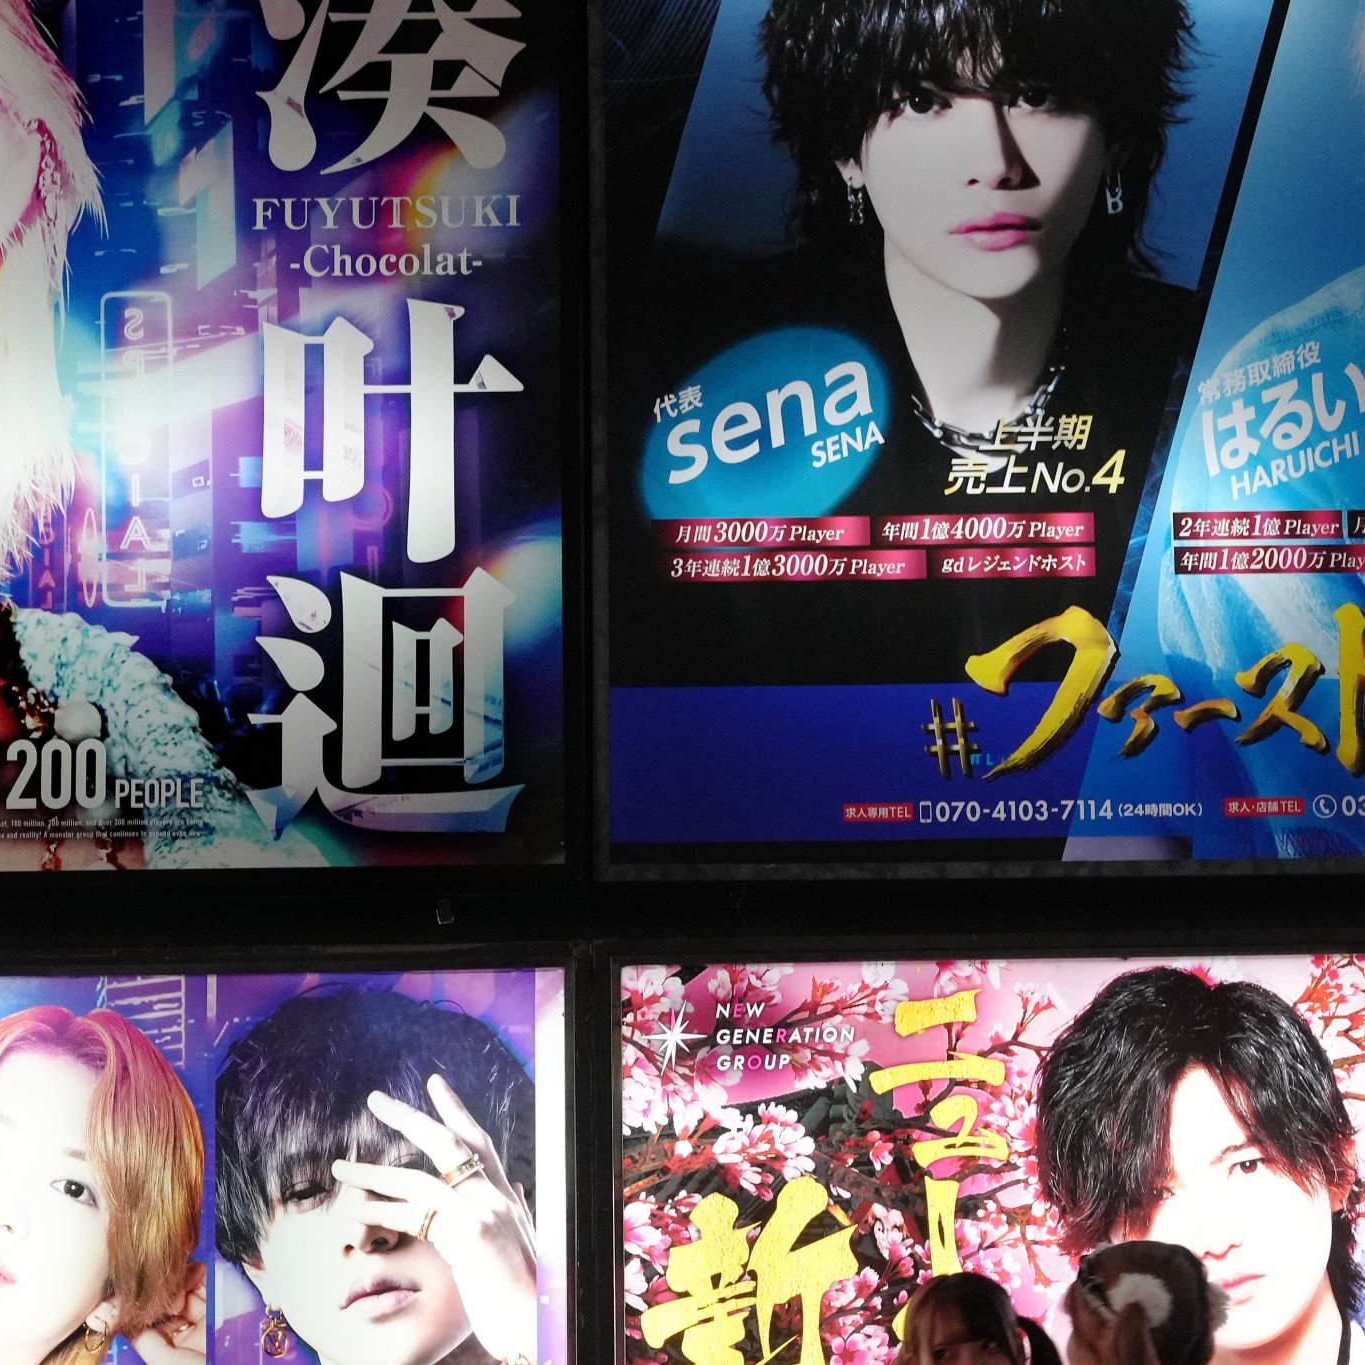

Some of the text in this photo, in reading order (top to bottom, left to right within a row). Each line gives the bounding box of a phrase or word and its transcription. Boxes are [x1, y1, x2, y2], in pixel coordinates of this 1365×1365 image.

[252, 195, 521, 232] FUYUTSUKI
[289, 243, 483, 279] -Chocolat-
[1197, 340, 1323, 405] 常務取締役
[653, 385, 703, 423] 代表
[666, 359, 873, 486] sena
[810, 420, 885, 469] SENA
[978, 414, 1094, 452] 上半期
[1229, 429, 1361, 500] HARUICHI
[115, 777, 203, 810] PEOPLE
[934, 799, 1114, 824] 070-4103-7114
[716, 1002, 766, 1019] NEW
[716, 1027, 855, 1046] GENERATION
[716, 1055, 791, 1071] GROUP
